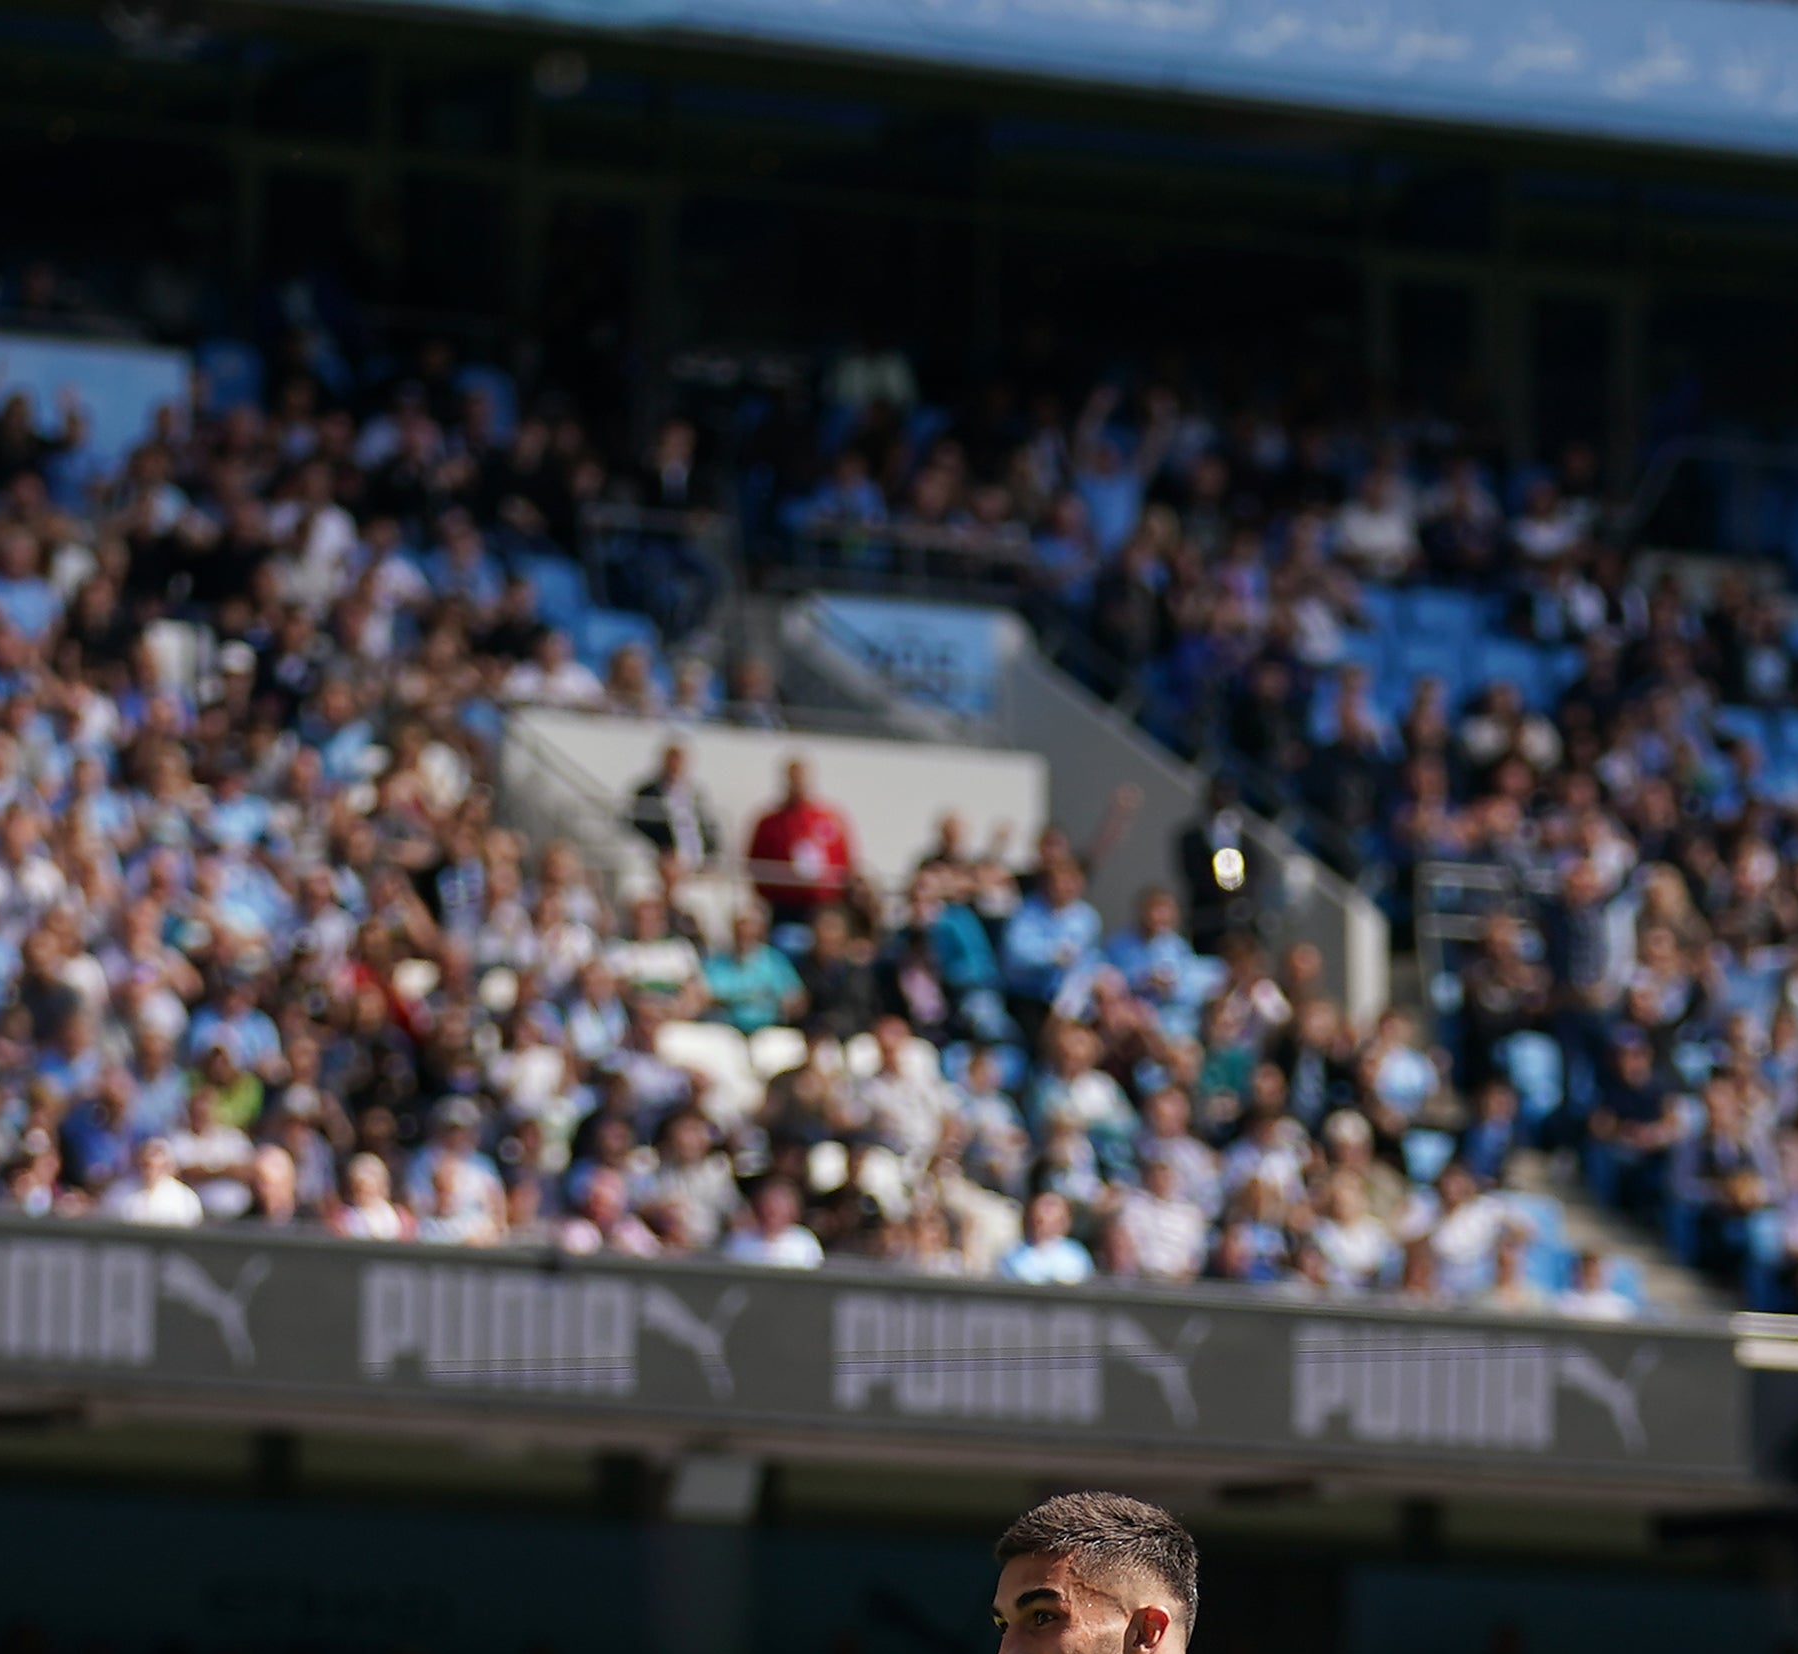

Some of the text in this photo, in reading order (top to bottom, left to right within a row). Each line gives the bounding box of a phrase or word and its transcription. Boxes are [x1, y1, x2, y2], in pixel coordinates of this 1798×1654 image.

[359, 1264, 638, 1397] PUMA
[832, 1290, 1103, 1427] PUMA
[1293, 1322, 1555, 1453] PUMA
